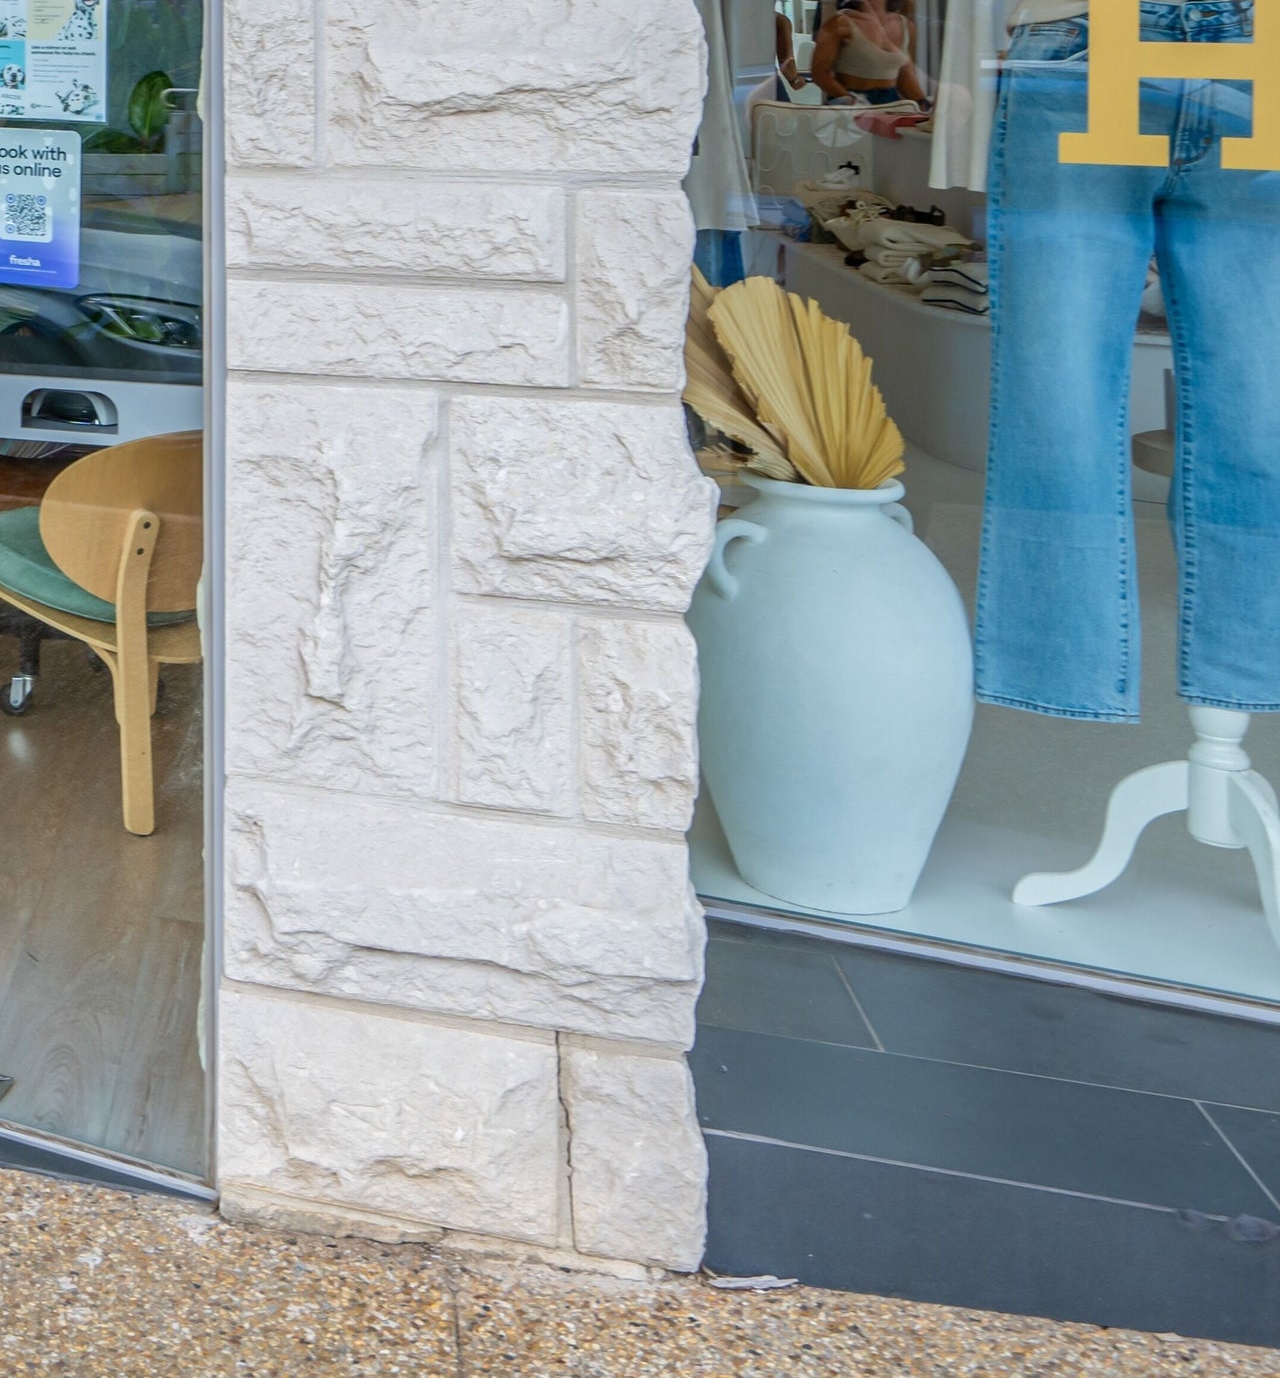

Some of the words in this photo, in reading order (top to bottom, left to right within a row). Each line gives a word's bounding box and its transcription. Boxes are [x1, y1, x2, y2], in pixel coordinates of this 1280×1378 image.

[32, 145, 67, 162] with
[13, 162, 62, 178] online
[8, 254, 42, 267] fresha
